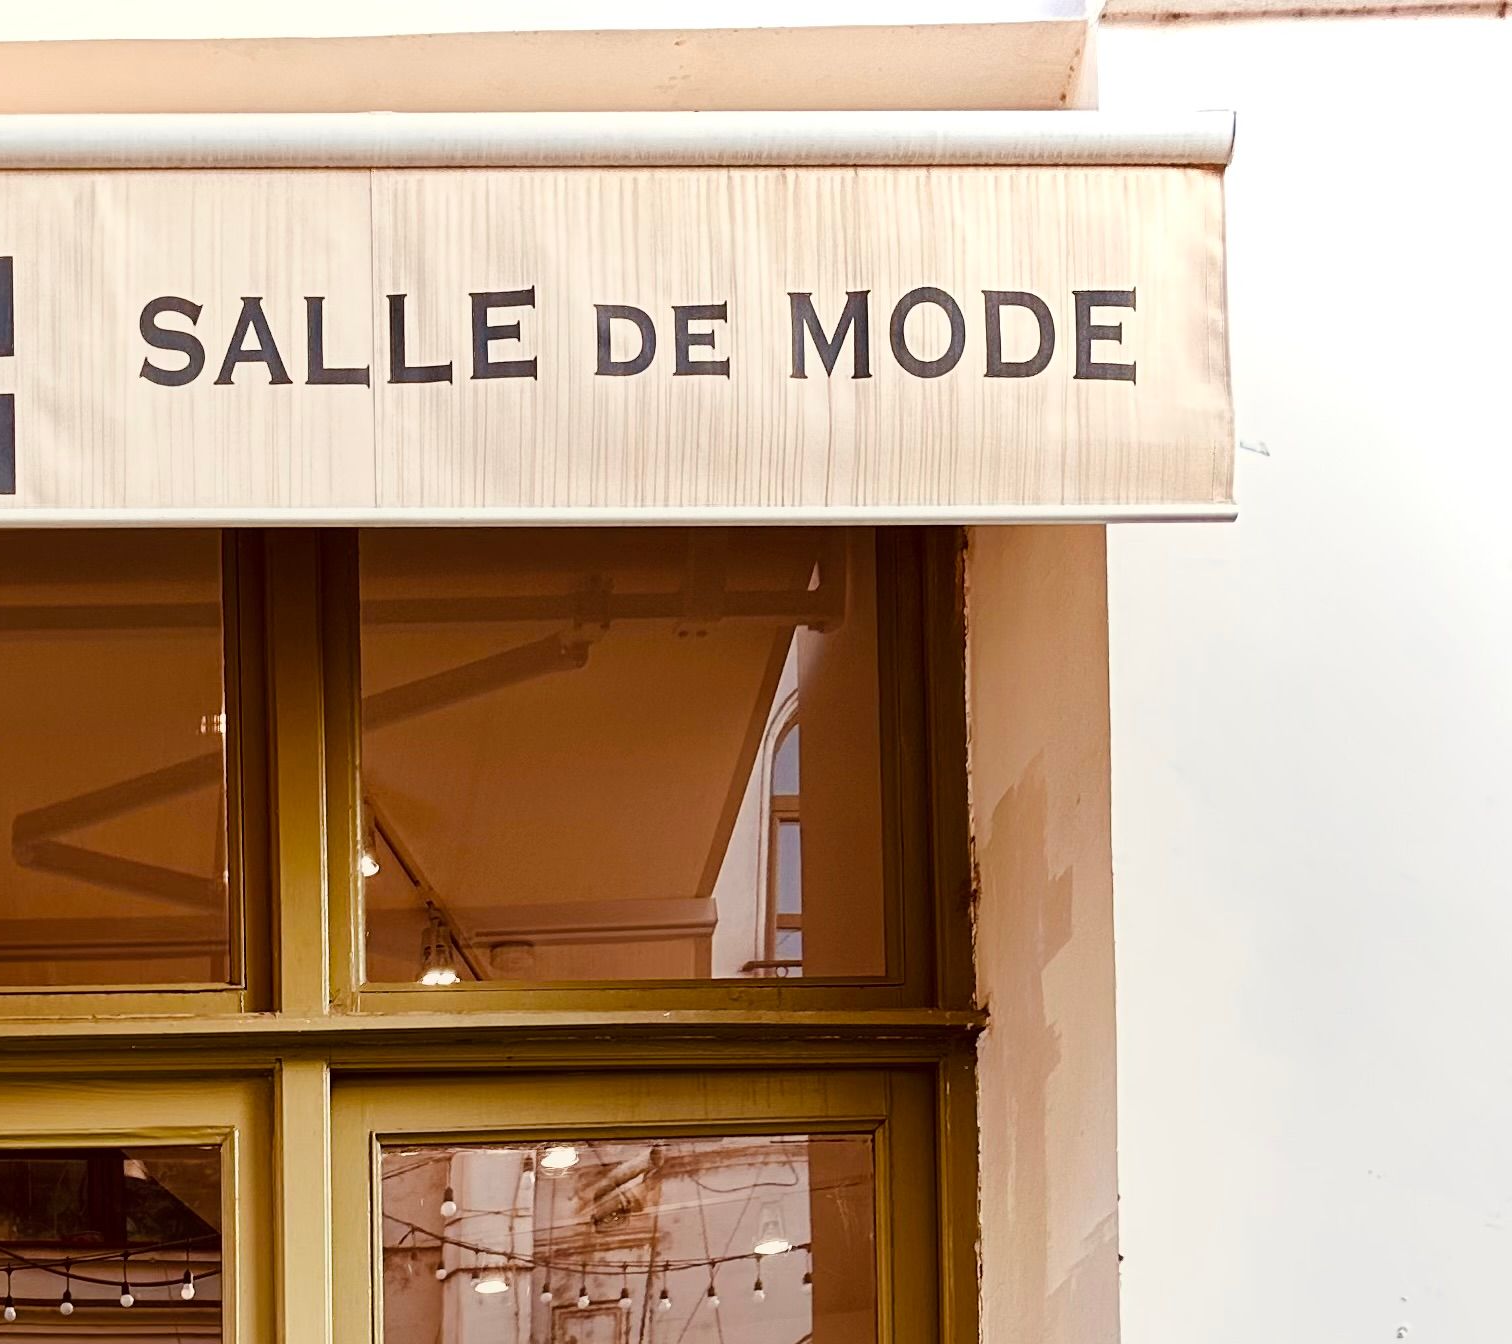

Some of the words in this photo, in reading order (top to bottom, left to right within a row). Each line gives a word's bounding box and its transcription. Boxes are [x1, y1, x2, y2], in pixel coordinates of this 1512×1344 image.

[138, 285, 538, 388] SALLE
[594, 300, 731, 378] DE
[787, 286, 1138, 386] MODE
